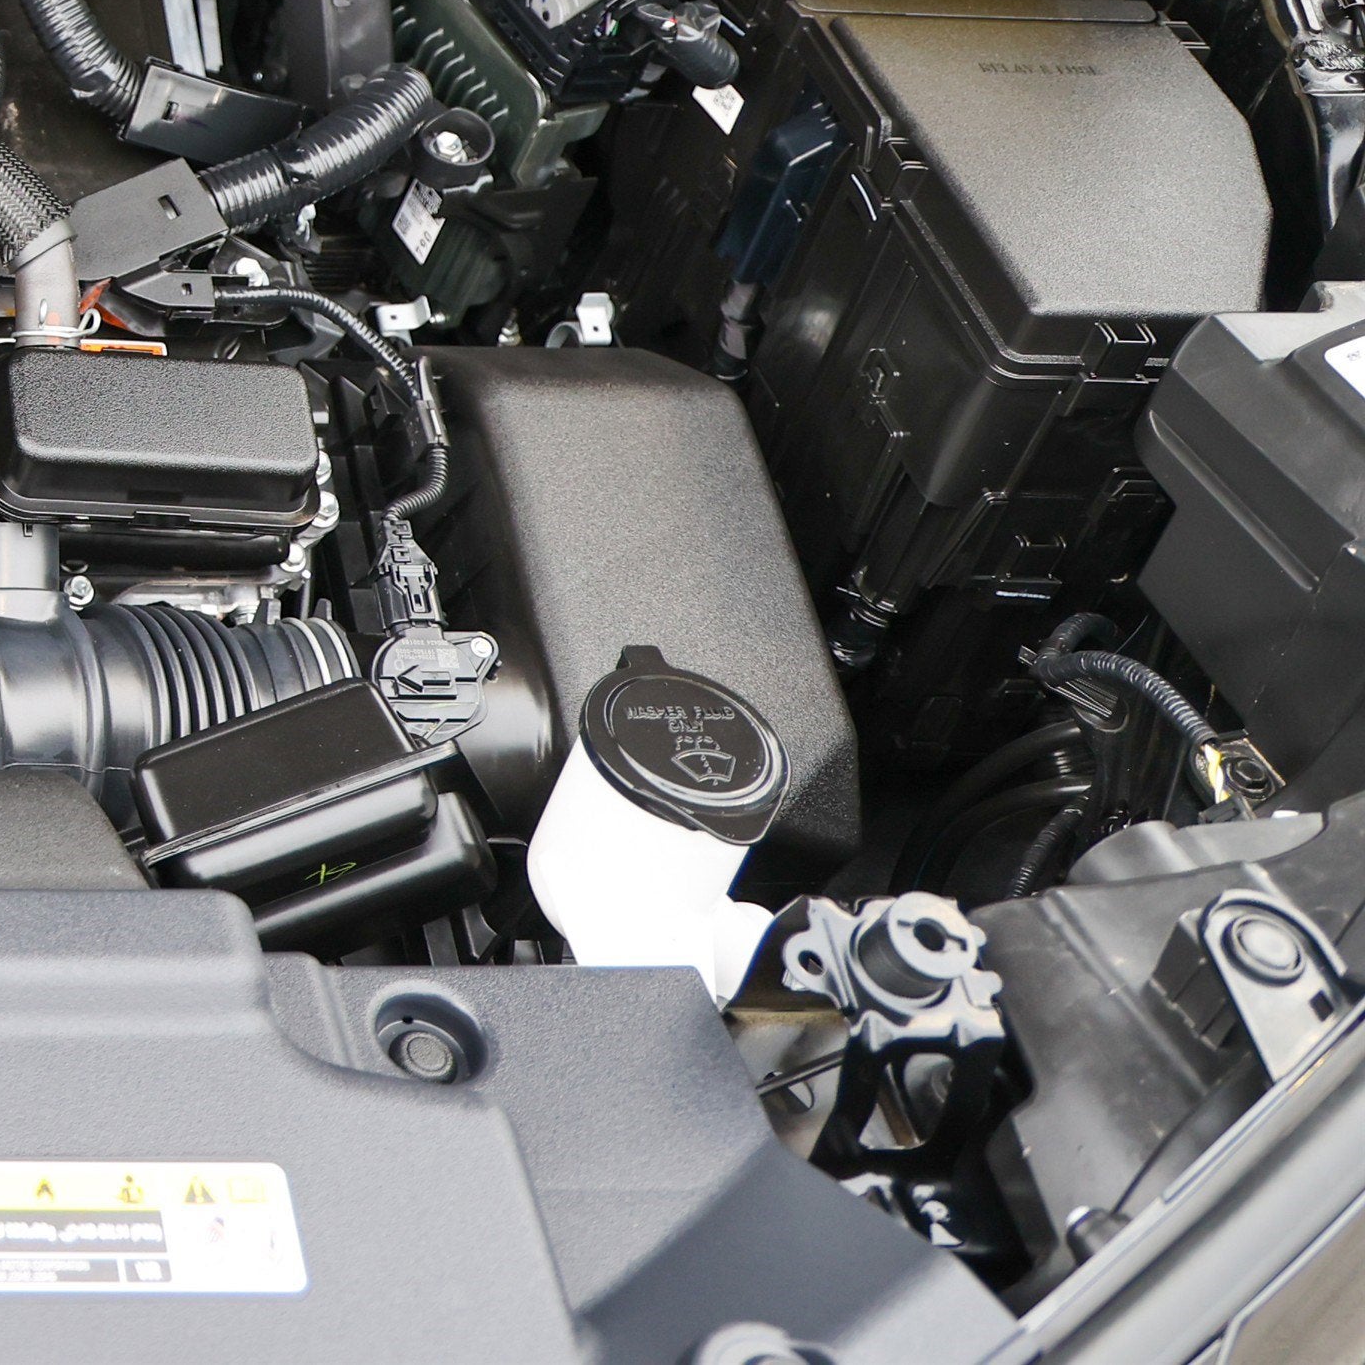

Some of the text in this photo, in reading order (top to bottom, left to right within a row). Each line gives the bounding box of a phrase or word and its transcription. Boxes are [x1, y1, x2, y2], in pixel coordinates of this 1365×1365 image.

[627, 706, 736, 721] WASHER FLUID
[668, 720, 705, 733] ONLY
